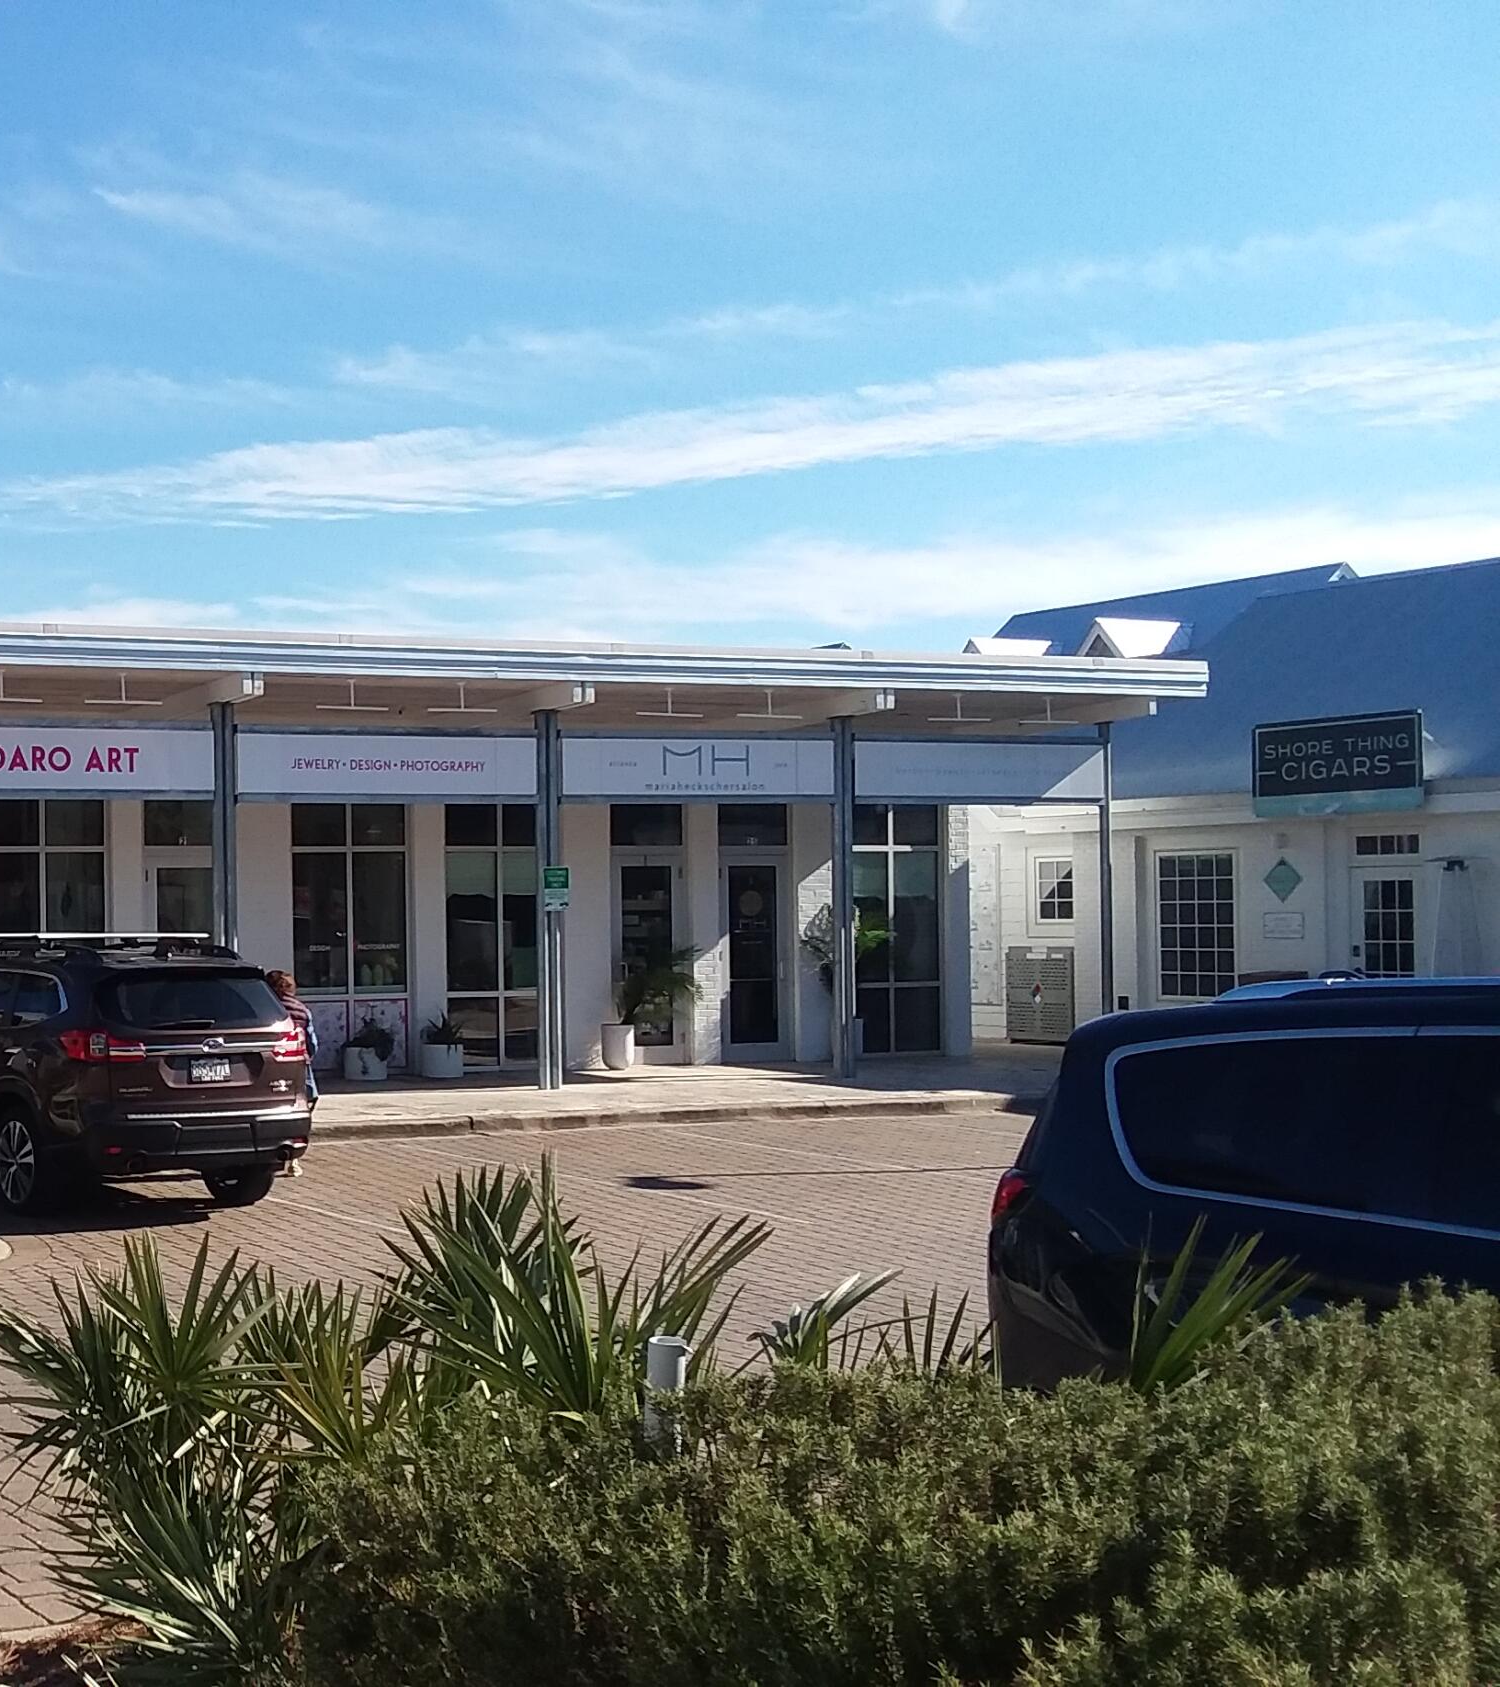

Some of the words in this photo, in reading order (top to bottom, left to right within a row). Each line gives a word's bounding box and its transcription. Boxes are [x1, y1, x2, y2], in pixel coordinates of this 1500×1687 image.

[84, 745, 140, 773] ART
[662, 744, 750, 777] MH
[1263, 739, 1334, 760] SHORE
[1343, 733, 1410, 752] THING
[291, 757, 341, 770] JEWELRY
[350, 759, 391, 771] DESIGN
[400, 760, 486, 773] PHOTOGRAPHY
[1281, 754, 1392, 782] CIGARS
